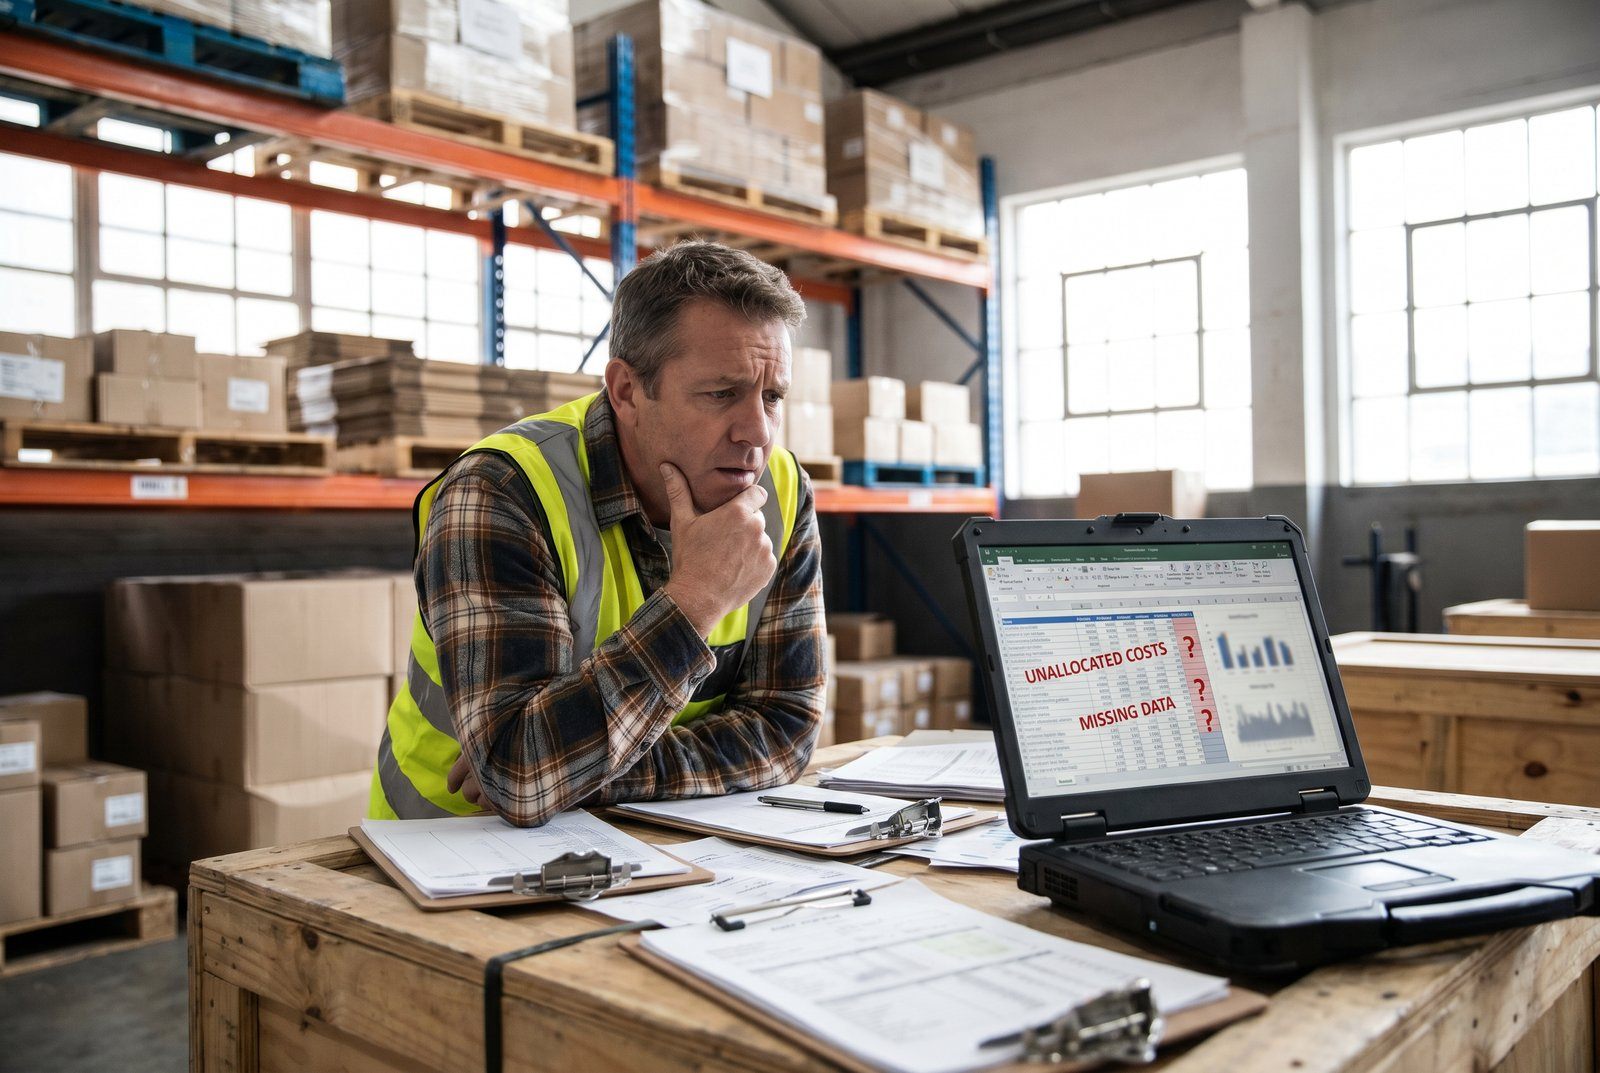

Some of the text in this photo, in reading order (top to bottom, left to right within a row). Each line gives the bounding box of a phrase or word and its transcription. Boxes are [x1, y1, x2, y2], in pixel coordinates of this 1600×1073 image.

[1182, 635, 1195, 658] ?
[1024, 641, 1168, 684] UNALLOCATED COSTS
[1193, 678, 1206, 701] ?
[1079, 696, 1177, 731] MISSING DATA
[1200, 708, 1213, 732] ?
